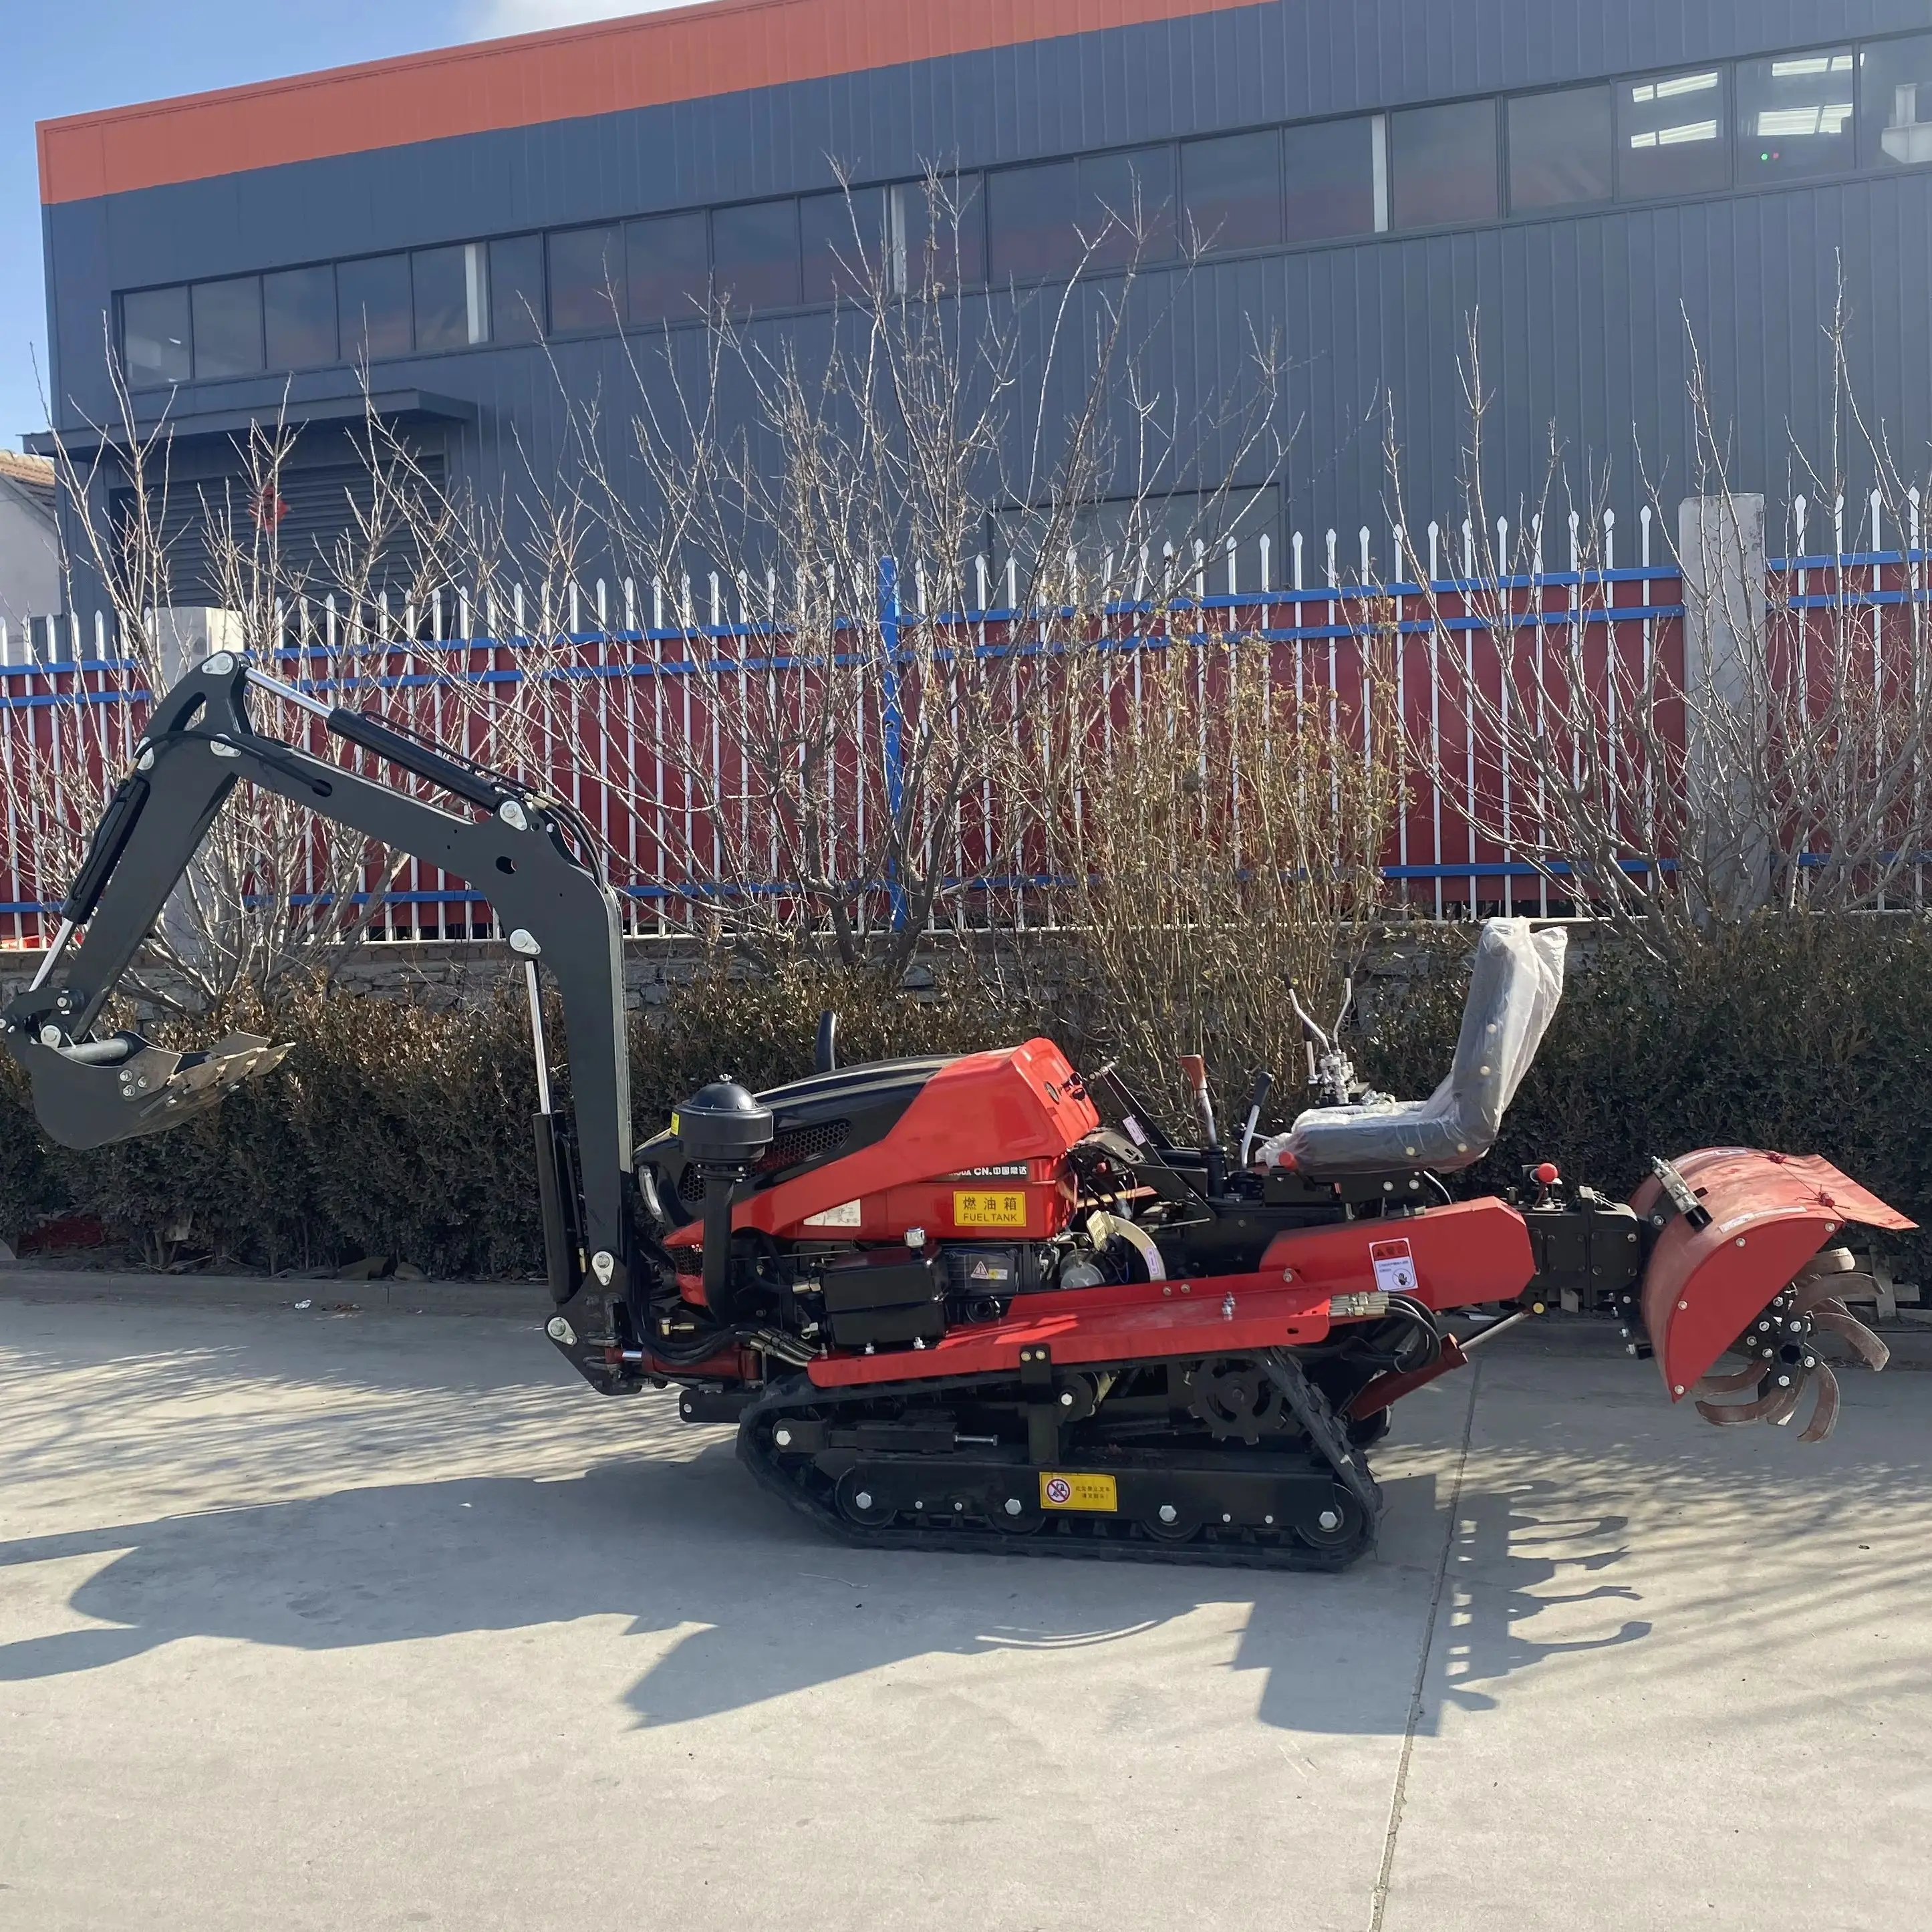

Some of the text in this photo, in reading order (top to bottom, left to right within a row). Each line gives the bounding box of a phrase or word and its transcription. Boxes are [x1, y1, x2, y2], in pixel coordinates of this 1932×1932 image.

[963, 1196, 1017, 1211] 燃油箱
[963, 1213, 1017, 1222] FUEL TANK
